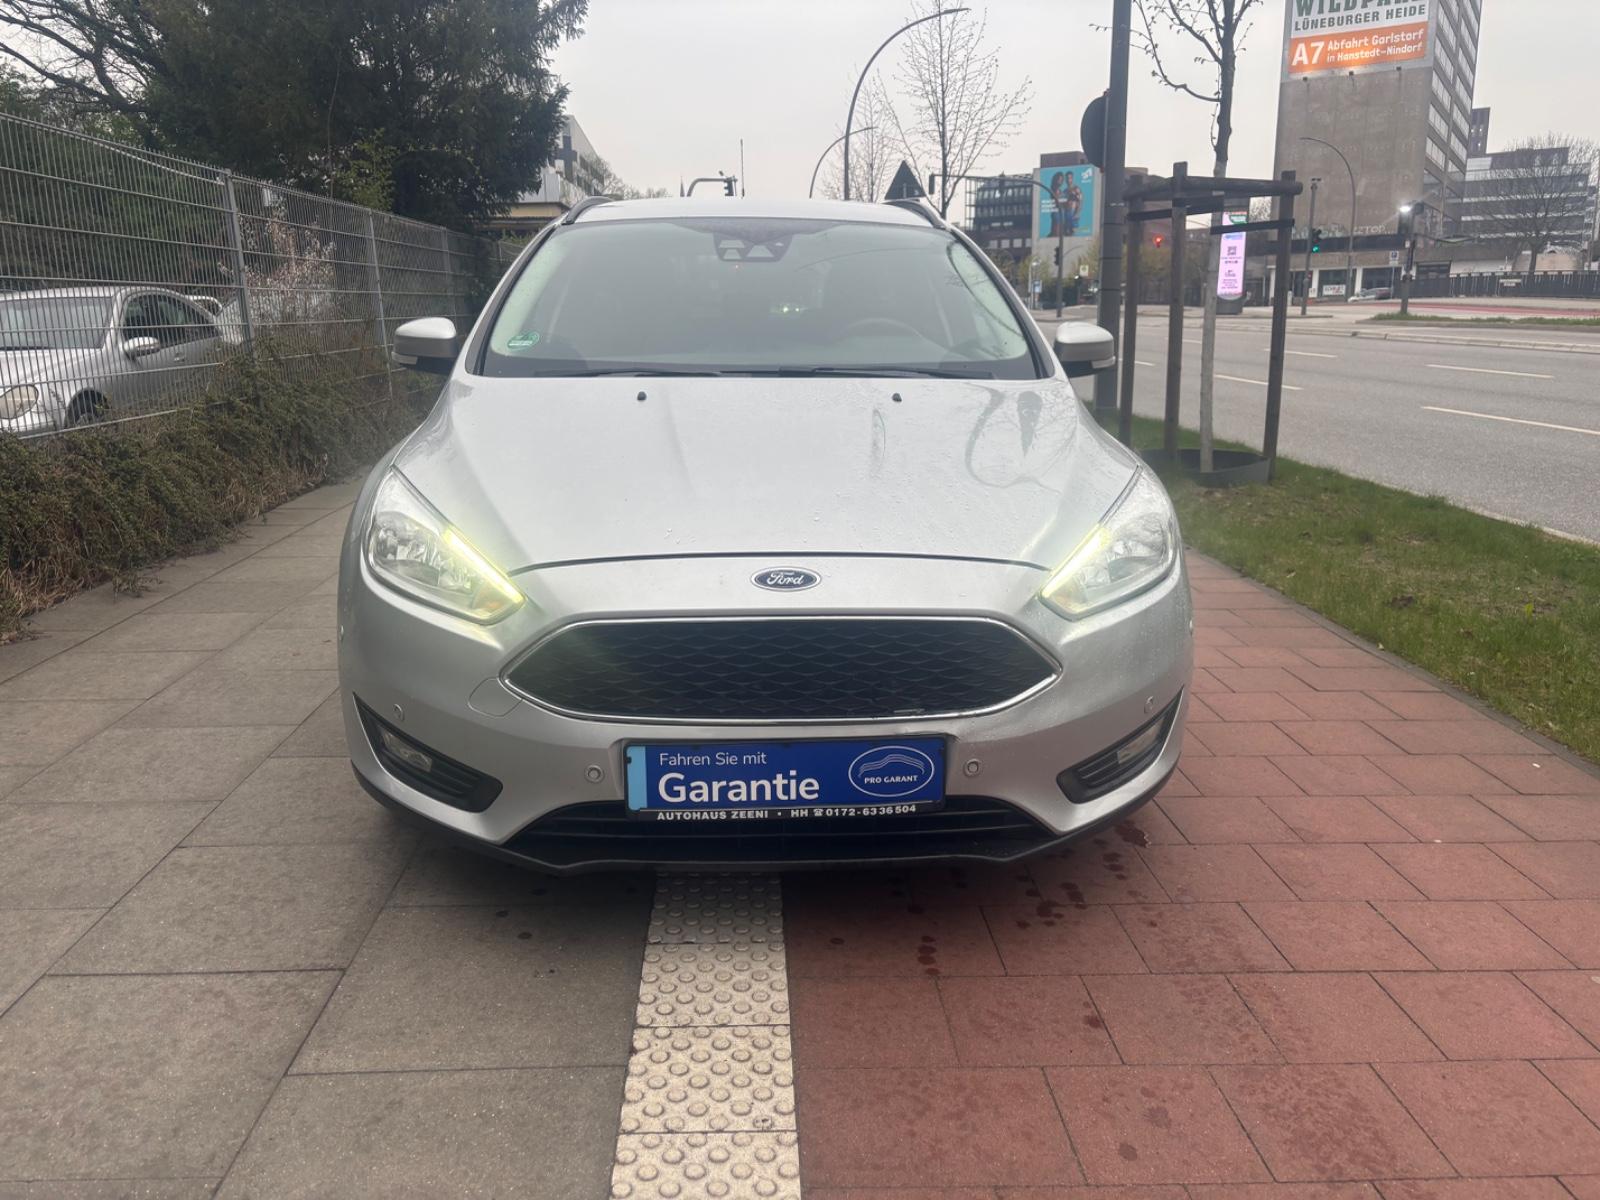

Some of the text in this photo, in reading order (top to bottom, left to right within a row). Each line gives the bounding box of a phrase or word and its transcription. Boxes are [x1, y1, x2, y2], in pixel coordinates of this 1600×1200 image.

[1296, 0, 1426, 17] WILDP
[1294, 4, 1426, 31] LÜNEBURGER HEIDE
[1327, 36, 1369, 51] Abfahrt
[1291, 41, 1325, 66] A7
[1327, 53, 1336, 63] in
[766, 572, 804, 585] Ford
[659, 752, 767, 766] Fahren Sie mit
[658, 769, 820, 803] Garantie
[883, 775, 918, 784] GARANT
[657, 811, 727, 820] AUTOHAUS
[731, 810, 769, 819] ZEENI
[790, 809, 808, 818] HH
